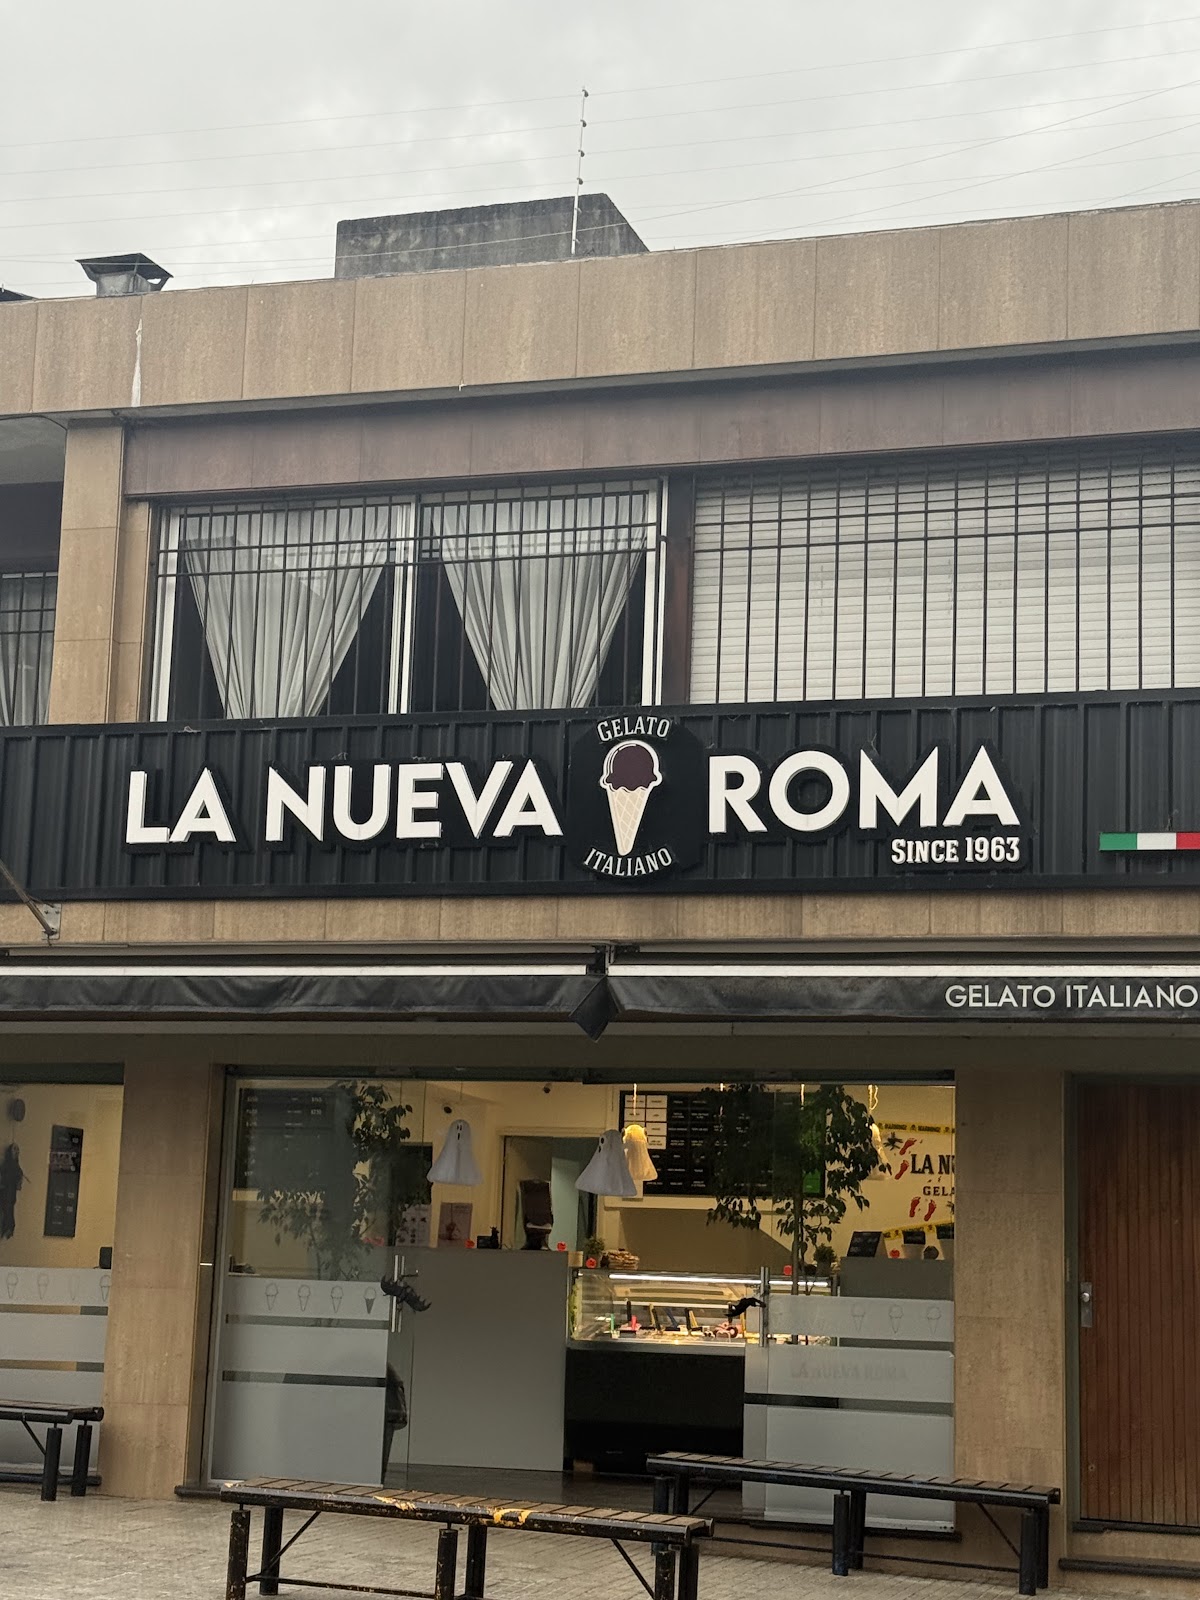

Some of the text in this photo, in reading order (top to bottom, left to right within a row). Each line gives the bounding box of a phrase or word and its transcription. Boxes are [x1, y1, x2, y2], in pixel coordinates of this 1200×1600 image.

[597, 716, 670, 742] GELATO
[126, 745, 1021, 845] LA NUEVA ROMA
[584, 847, 672, 877] ITALIANO
[965, 836, 1020, 863] 1963
[945, 984, 1199, 1008] GELATO ITALIANO
[910, 1154, 934, 1174] LA
